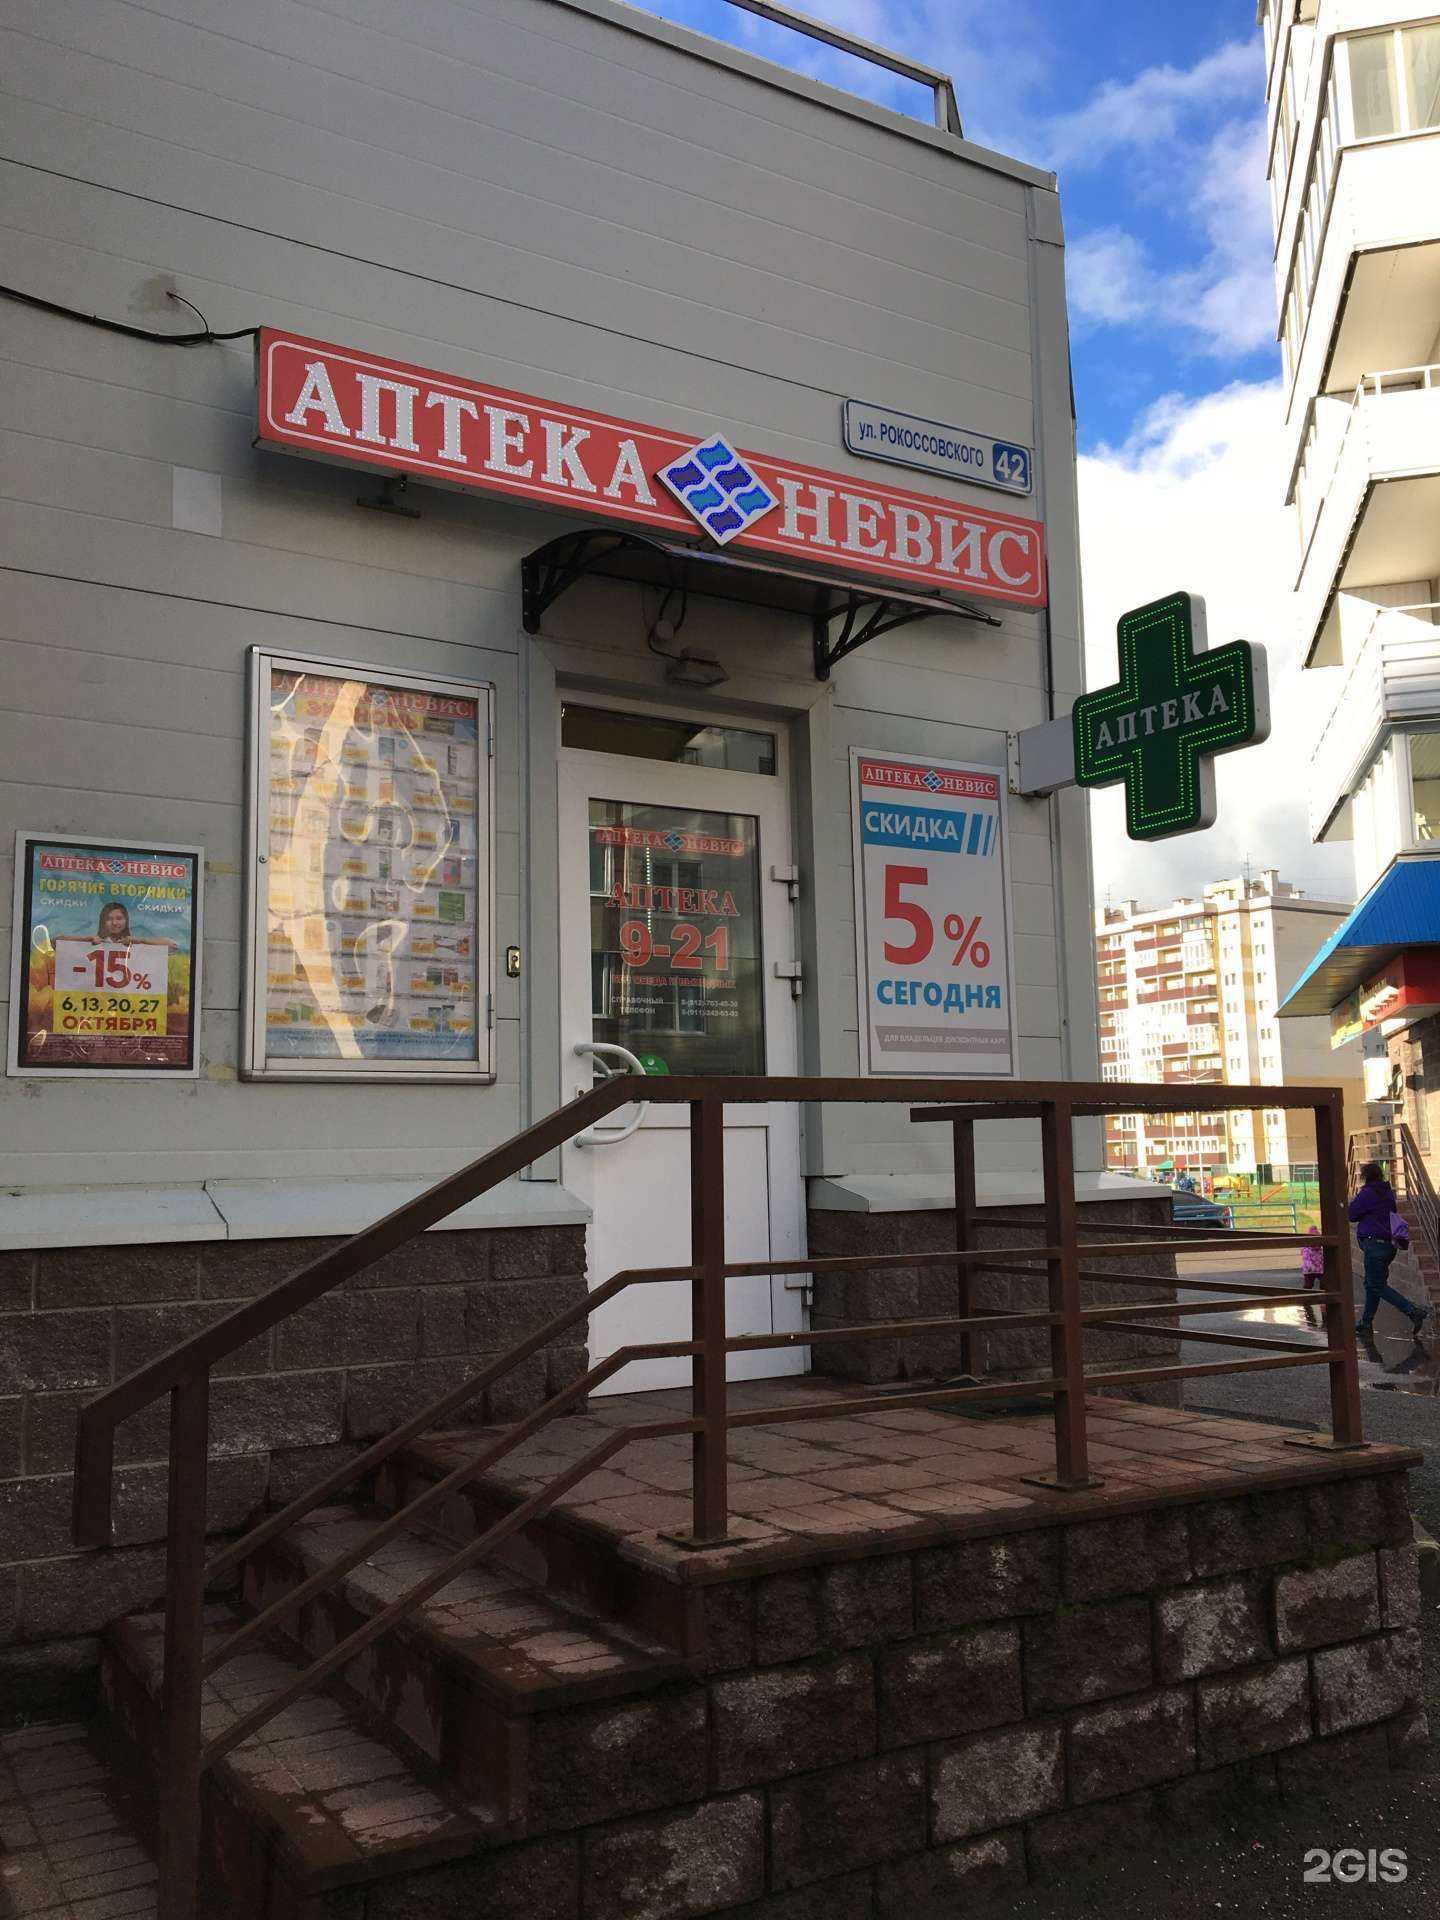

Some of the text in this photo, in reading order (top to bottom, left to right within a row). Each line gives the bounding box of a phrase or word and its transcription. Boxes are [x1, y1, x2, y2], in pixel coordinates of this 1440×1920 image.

[859, 421, 1025, 483] ул. РОКОССОВСКОГО 42
[285, 361, 1032, 586] АПТЕКА НЕВИС
[1095, 684, 1230, 750] АПТЕКА
[865, 767, 995, 794] АПТЕКА НЕВИС
[865, 811, 959, 842] СКИДКА
[44, 855, 185, 877] АПТЕКА НЕВИС
[39, 878, 186, 899] ГОРЯЧИЕ ВТОРНИКИ
[606, 882, 740, 917] АПТЕКА
[620, 920, 729, 971] 9-21
[62, 997, 160, 1014] 6, 13, 20, 27
[876, 979, 1001, 1013] СЕГОДНЯ
[62, 1015, 157, 1031] ОКТЯБРЯ
